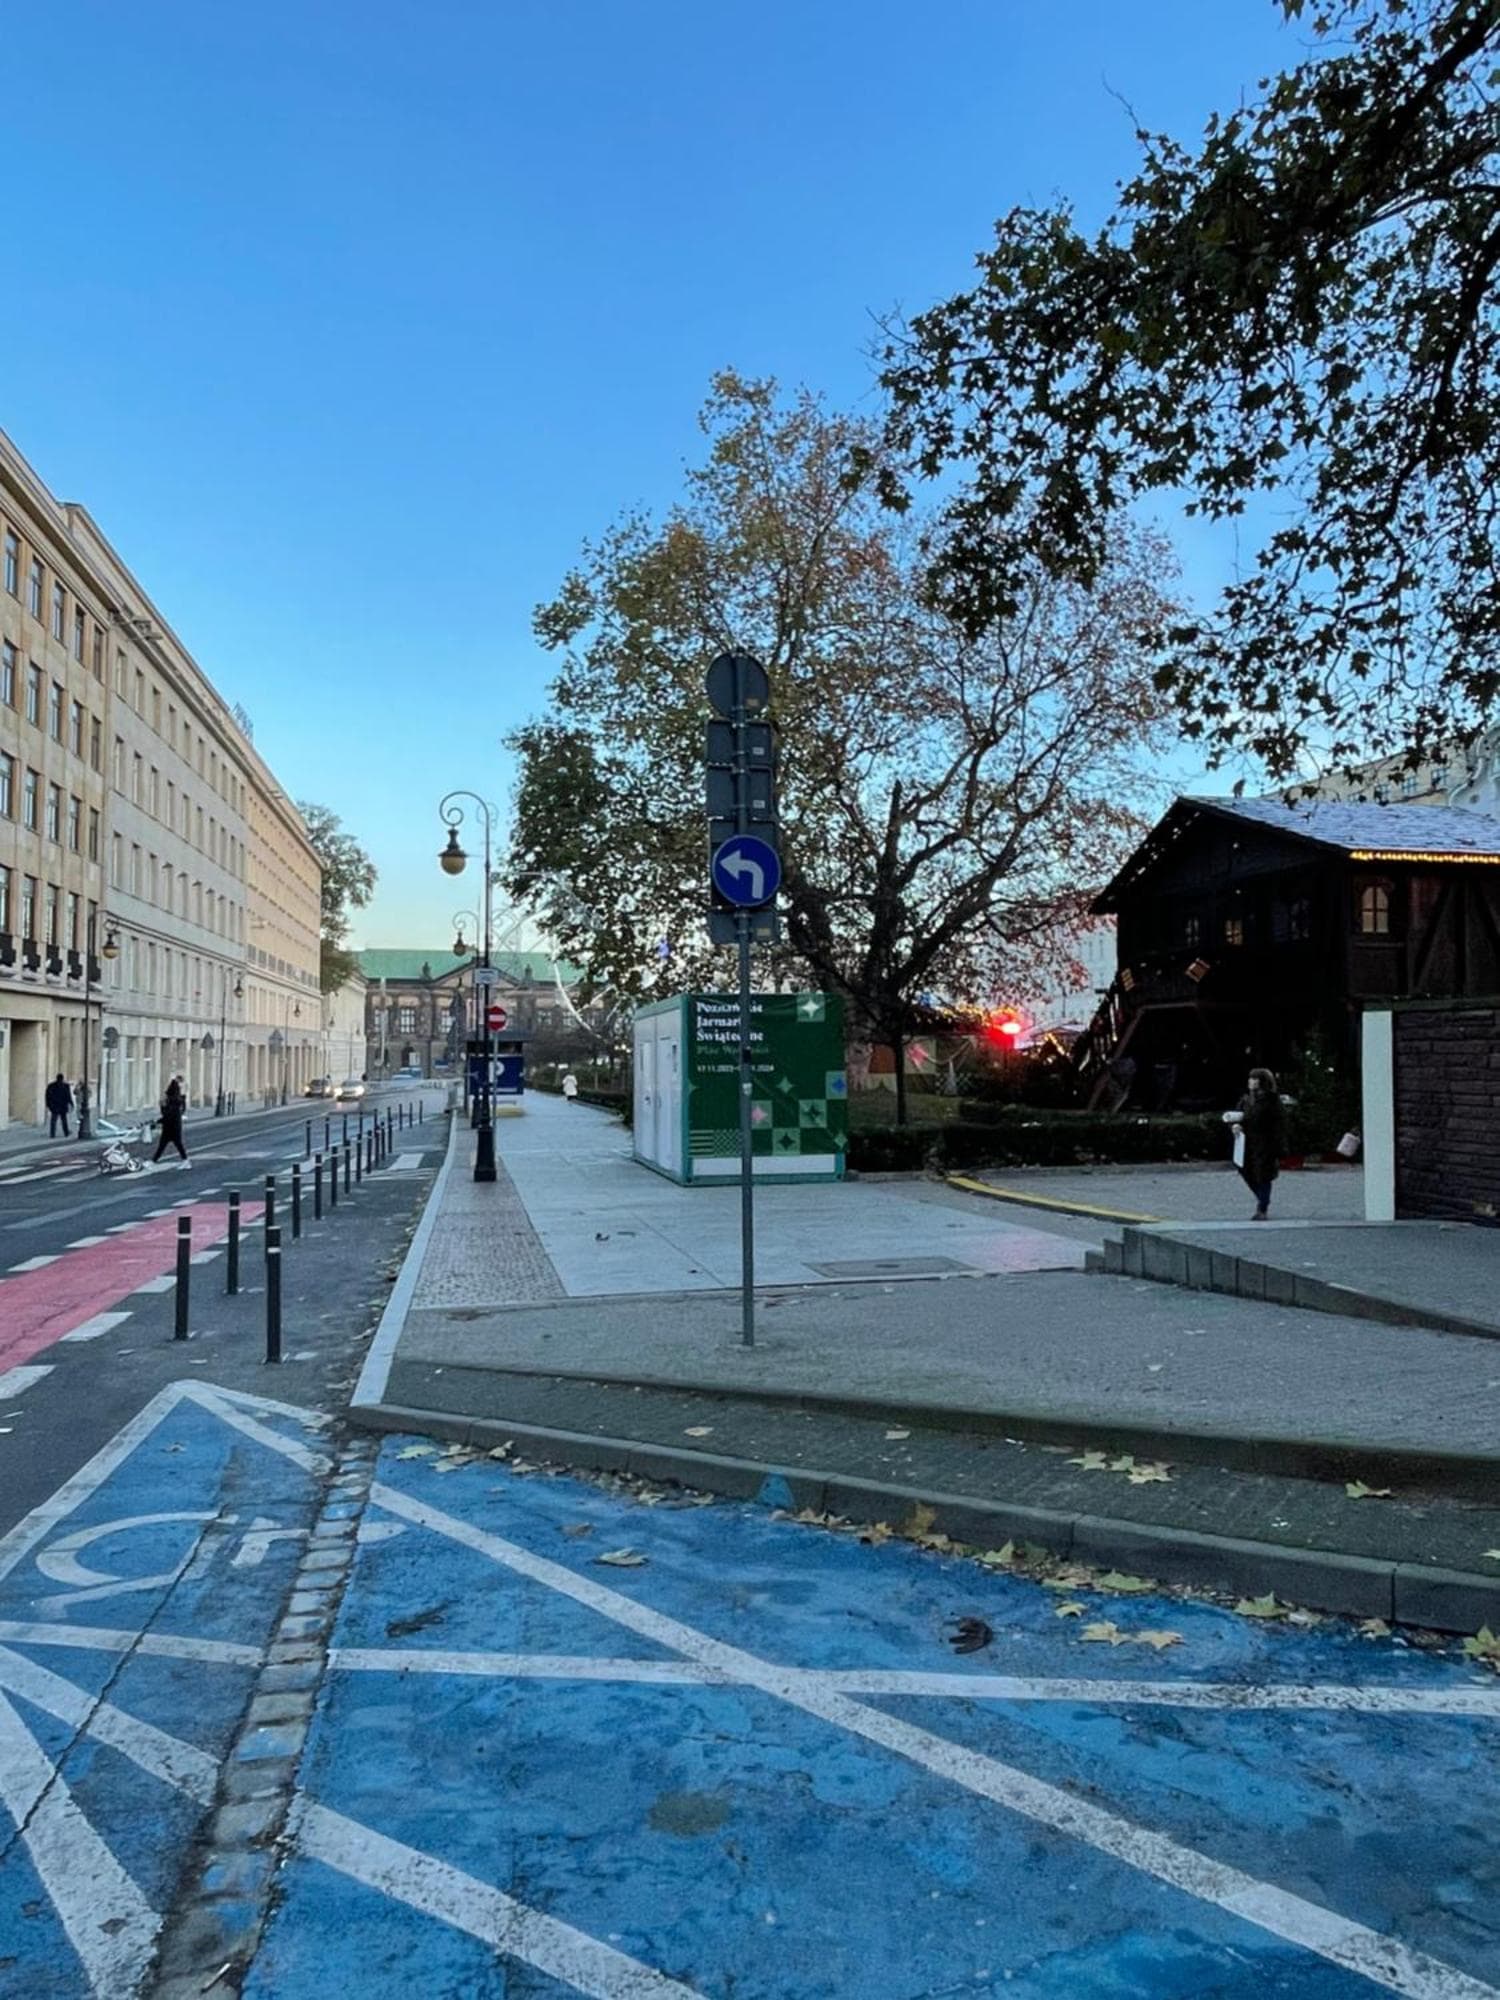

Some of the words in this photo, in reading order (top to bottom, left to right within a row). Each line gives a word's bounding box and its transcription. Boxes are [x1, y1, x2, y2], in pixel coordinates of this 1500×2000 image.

[696, 1001, 763, 1013] Poznańie
[696, 1015, 741, 1029] Jarmar
[696, 1027, 764, 1043] Świątecne
